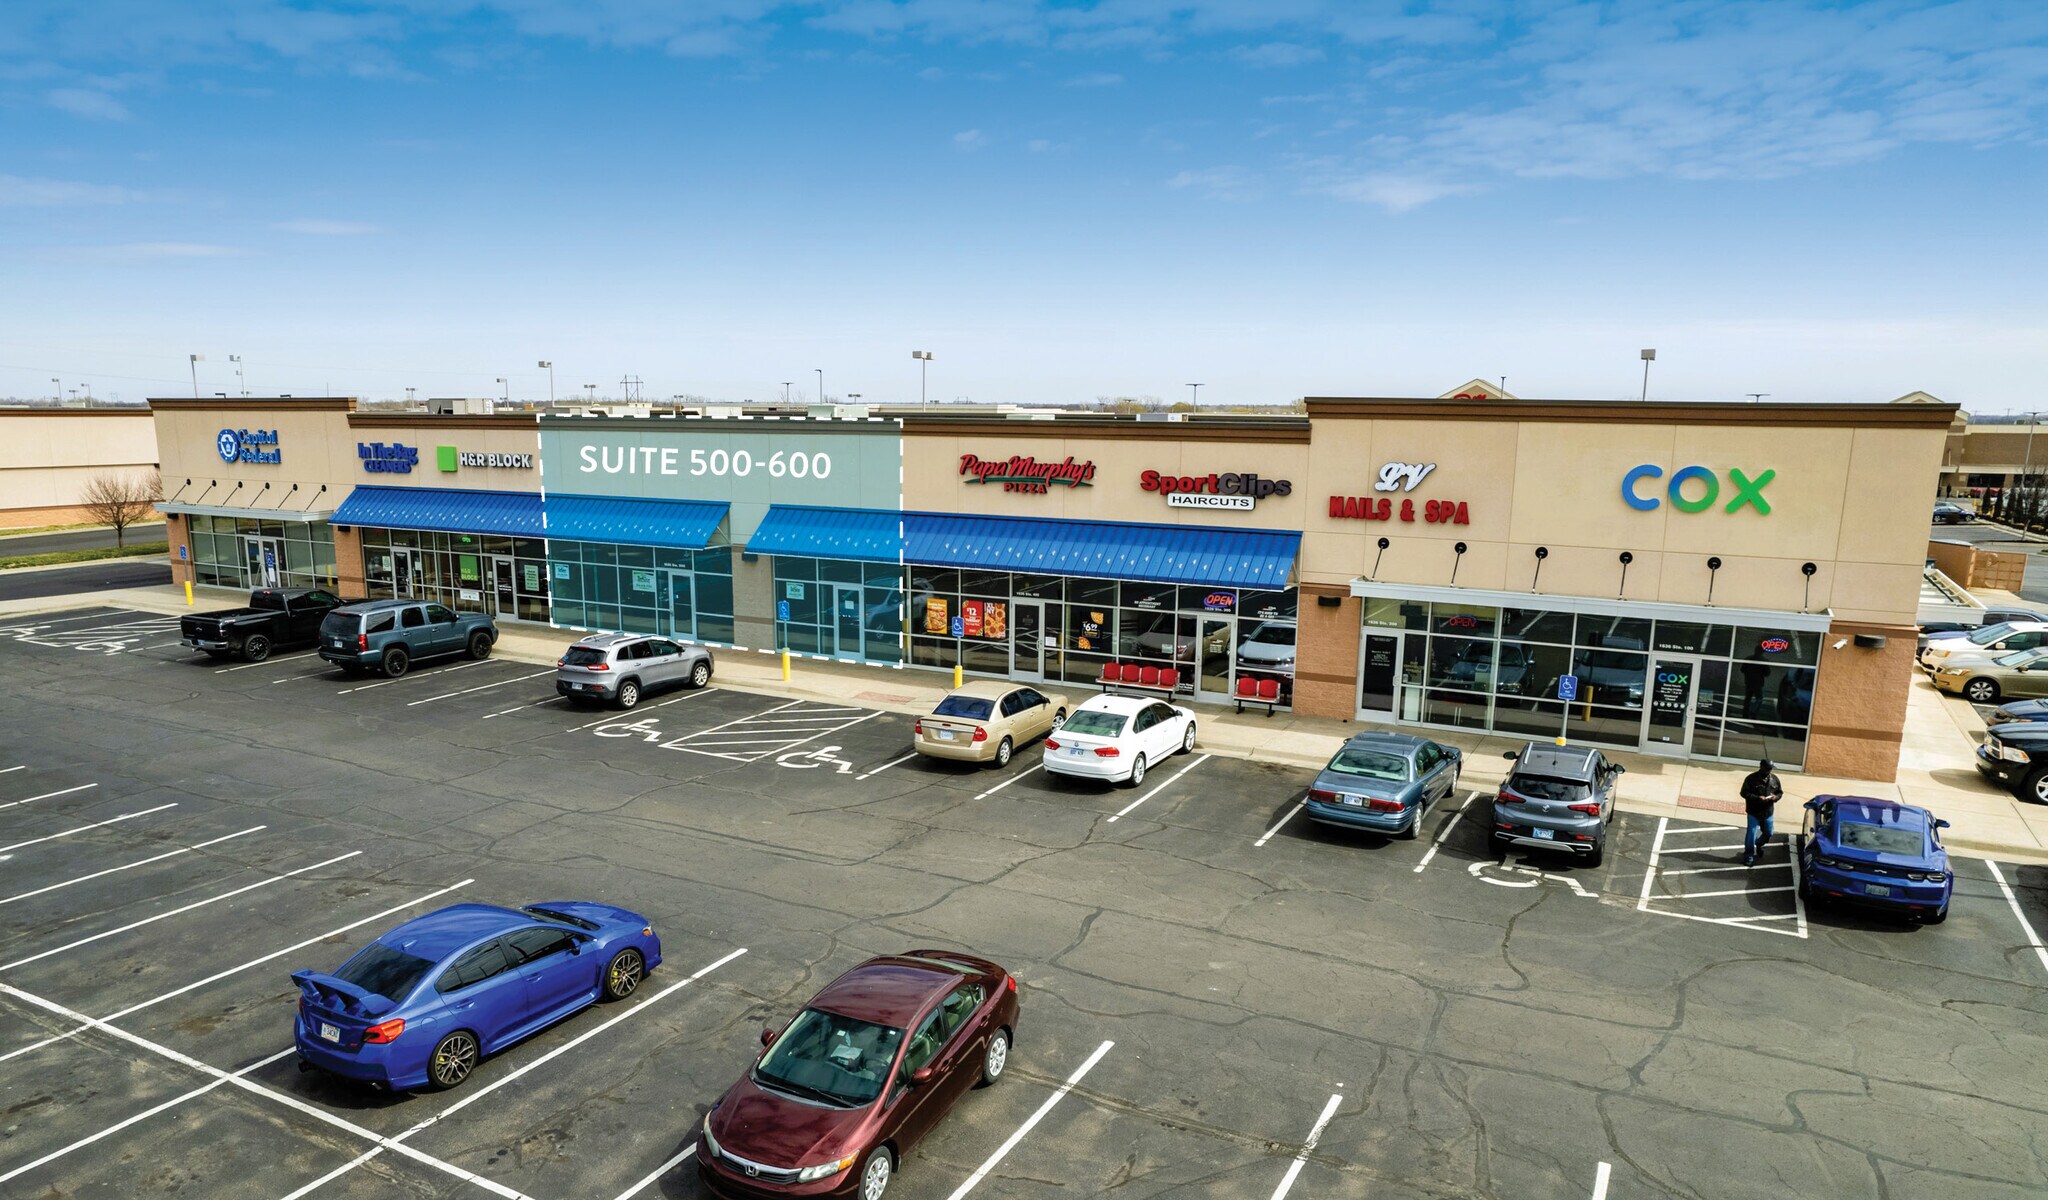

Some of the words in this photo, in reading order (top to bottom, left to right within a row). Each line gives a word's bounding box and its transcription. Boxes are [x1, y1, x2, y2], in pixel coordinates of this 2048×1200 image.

[357, 442, 371, 458] In
[370, 442, 393, 459] The
[393, 442, 418, 465] Bag
[460, 452, 487, 467] H&R
[488, 453, 532, 468] BLOCK
[364, 460, 412, 473] CLEANERS
[960, 454, 1008, 485] Papa
[1008, 456, 1096, 488] Murphy's
[1004, 482, 1048, 494] PIZZA
[1622, 464, 1776, 515] COX
[1172, 496, 1250, 507] HAIRCUTS
[1329, 496, 1392, 521] NAILS
[1400, 498, 1415, 522] &
[1424, 500, 1470, 525] SPA
[1206, 594, 1233, 606] OPEN
[1449, 617, 1477, 628] OPEN
[1761, 640, 1788, 650] OPEN
[1658, 673, 1688, 684] COX
